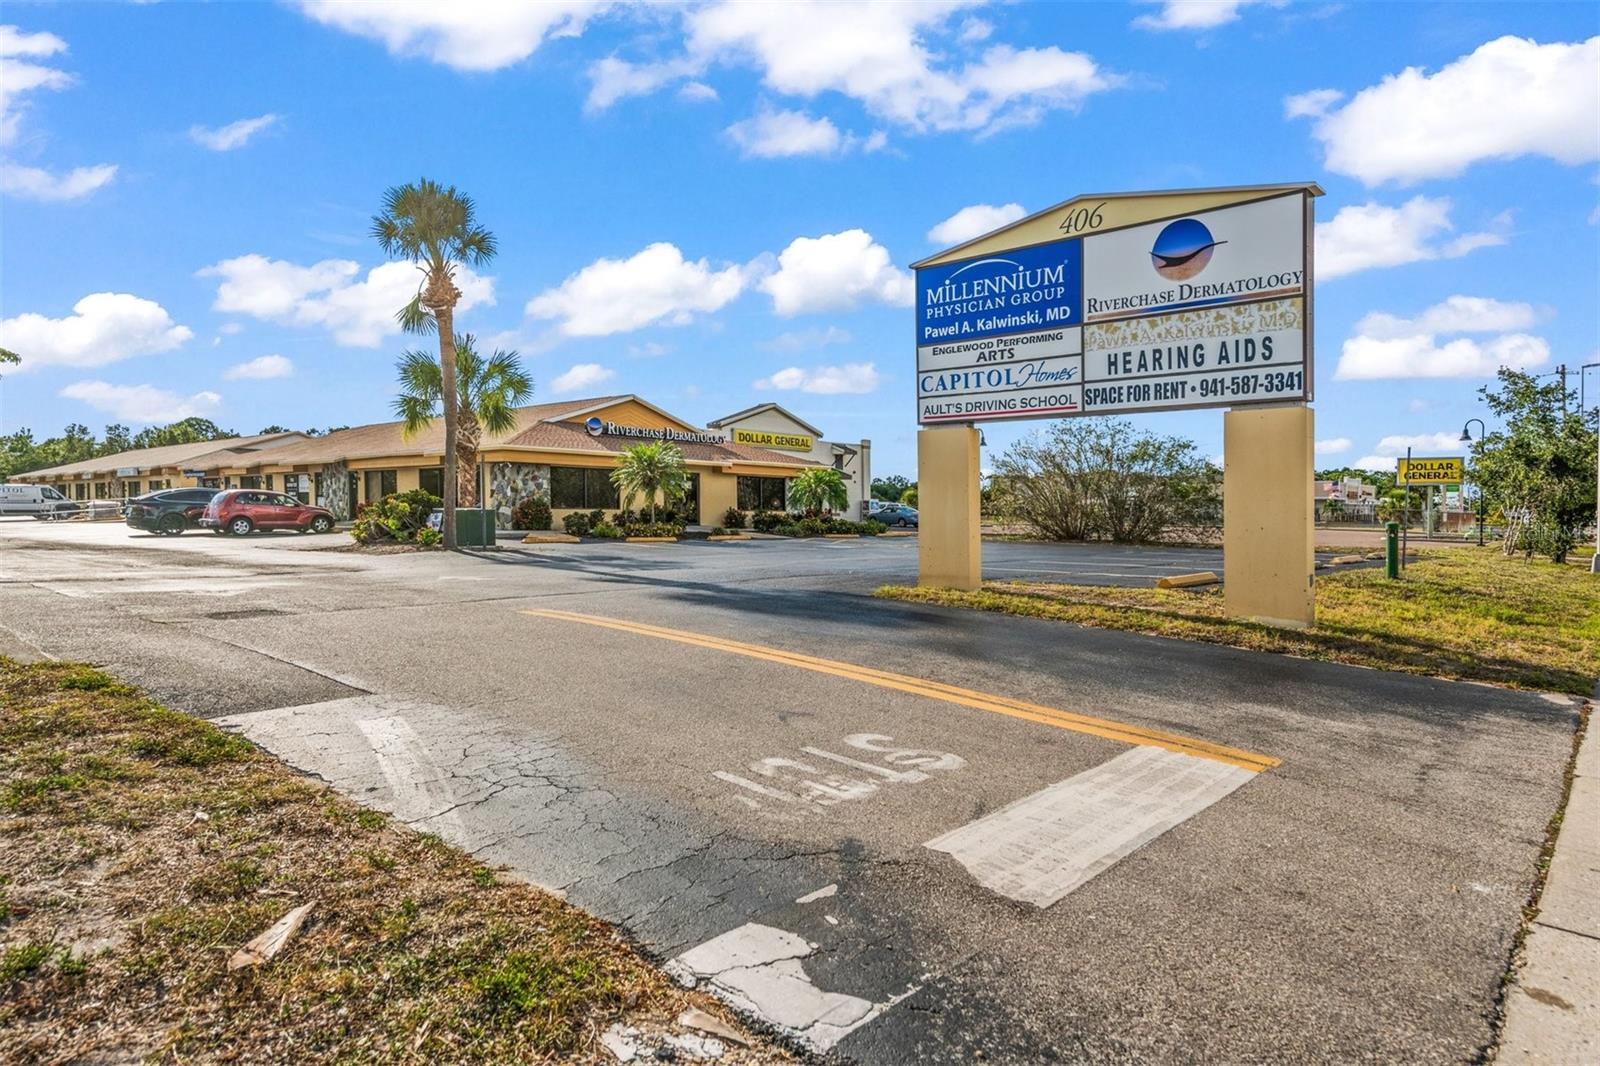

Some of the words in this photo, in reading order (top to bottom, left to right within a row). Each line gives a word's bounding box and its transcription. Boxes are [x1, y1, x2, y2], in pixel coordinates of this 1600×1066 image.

[1059, 202, 1106, 234] 406
[926, 264, 1065, 306] MILLENNIUM
[1087, 289, 1174, 313] RIVERCHASE
[1179, 270, 1303, 300] DERMATOLOGY
[926, 297, 1005, 319] PHYSICIAN
[1011, 287, 1065, 306] GROUP
[924, 324, 959, 339] Pawel
[961, 322, 974, 333] A.
[977, 310, 1043, 331] Kalwinski,
[1046, 306, 1071, 321] MD
[932, 341, 994, 356] ENGLEWOOD
[996, 332, 1063, 348] PERFORMING
[976, 348, 1015, 363] ARTS
[1107, 343, 1205, 376] HEARING
[1217, 336, 1274, 365] AIDS
[921, 368, 1018, 393] CAPITOL
[1016, 361, 1078, 387] Homes
[1085, 386, 1123, 406] SPACE
[1126, 384, 1150, 402] FOR
[1154, 381, 1188, 400] RENT
[1200, 371, 1302, 398] 941-587-3341
[923, 403, 963, 416] AULT'S
[966, 398, 1017, 413] DRIVING
[1020, 394, 1077, 408] SCHOOL
[607, 421, 665, 439] RIVERCHASE
[666, 426, 726, 444] DERMATOLOGY
[738, 432, 773, 445] DOLLAR
[775, 435, 810, 448] GENERAL
[1404, 471, 1457, 480] GENERAL
[1408, 462, 1454, 471] DOLLAR
